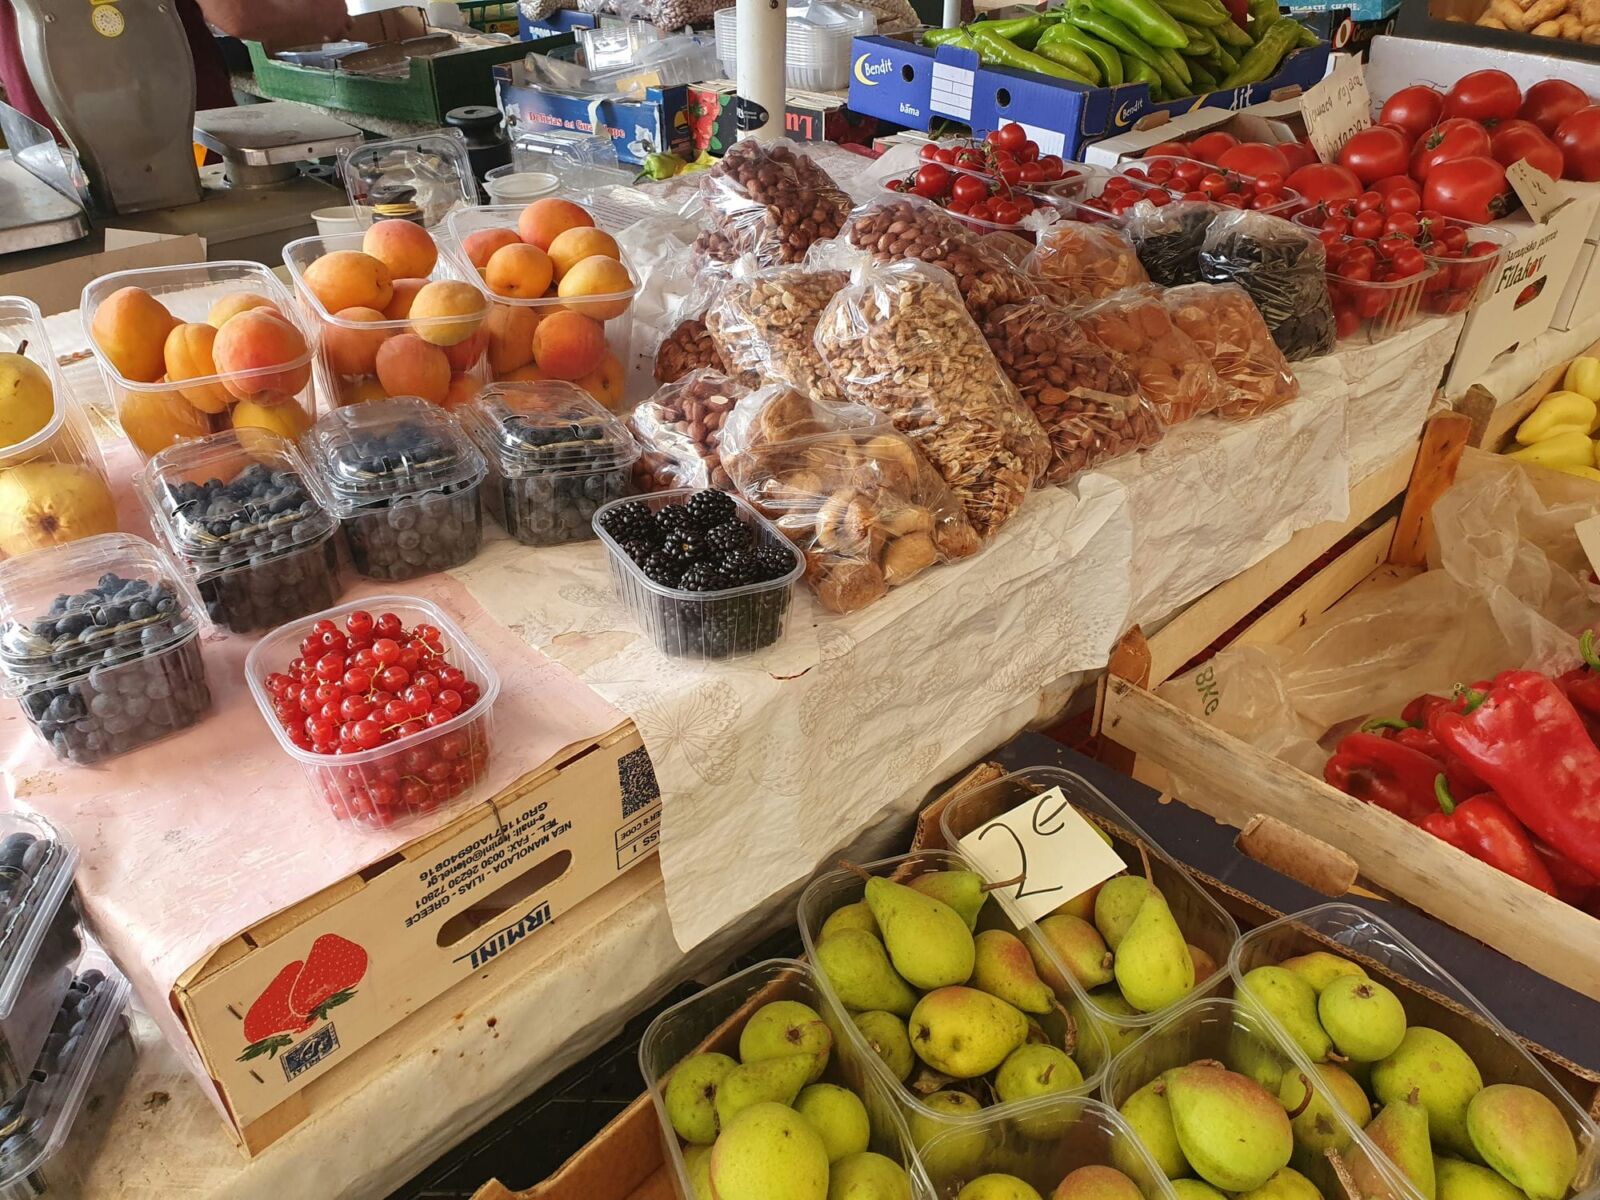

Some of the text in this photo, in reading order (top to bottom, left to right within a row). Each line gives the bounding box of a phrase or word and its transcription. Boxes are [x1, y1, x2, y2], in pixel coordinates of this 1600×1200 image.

[864, 58, 893, 76] Bendit
[1122, 98, 1143, 119] Bendit
[528, 112, 562, 127] Delicias
[552, 820, 572, 838] NEA
[621, 823, 642, 840] CODE
[493, 835, 550, 873] MANOLADA
[507, 837, 529, 853] FAX:
[481, 851, 505, 869] 0030
[448, 866, 480, 889] 26230
[458, 875, 485, 895] ILIAS
[415, 884, 446, 909] 72801
[404, 895, 450, 928] GREECE
